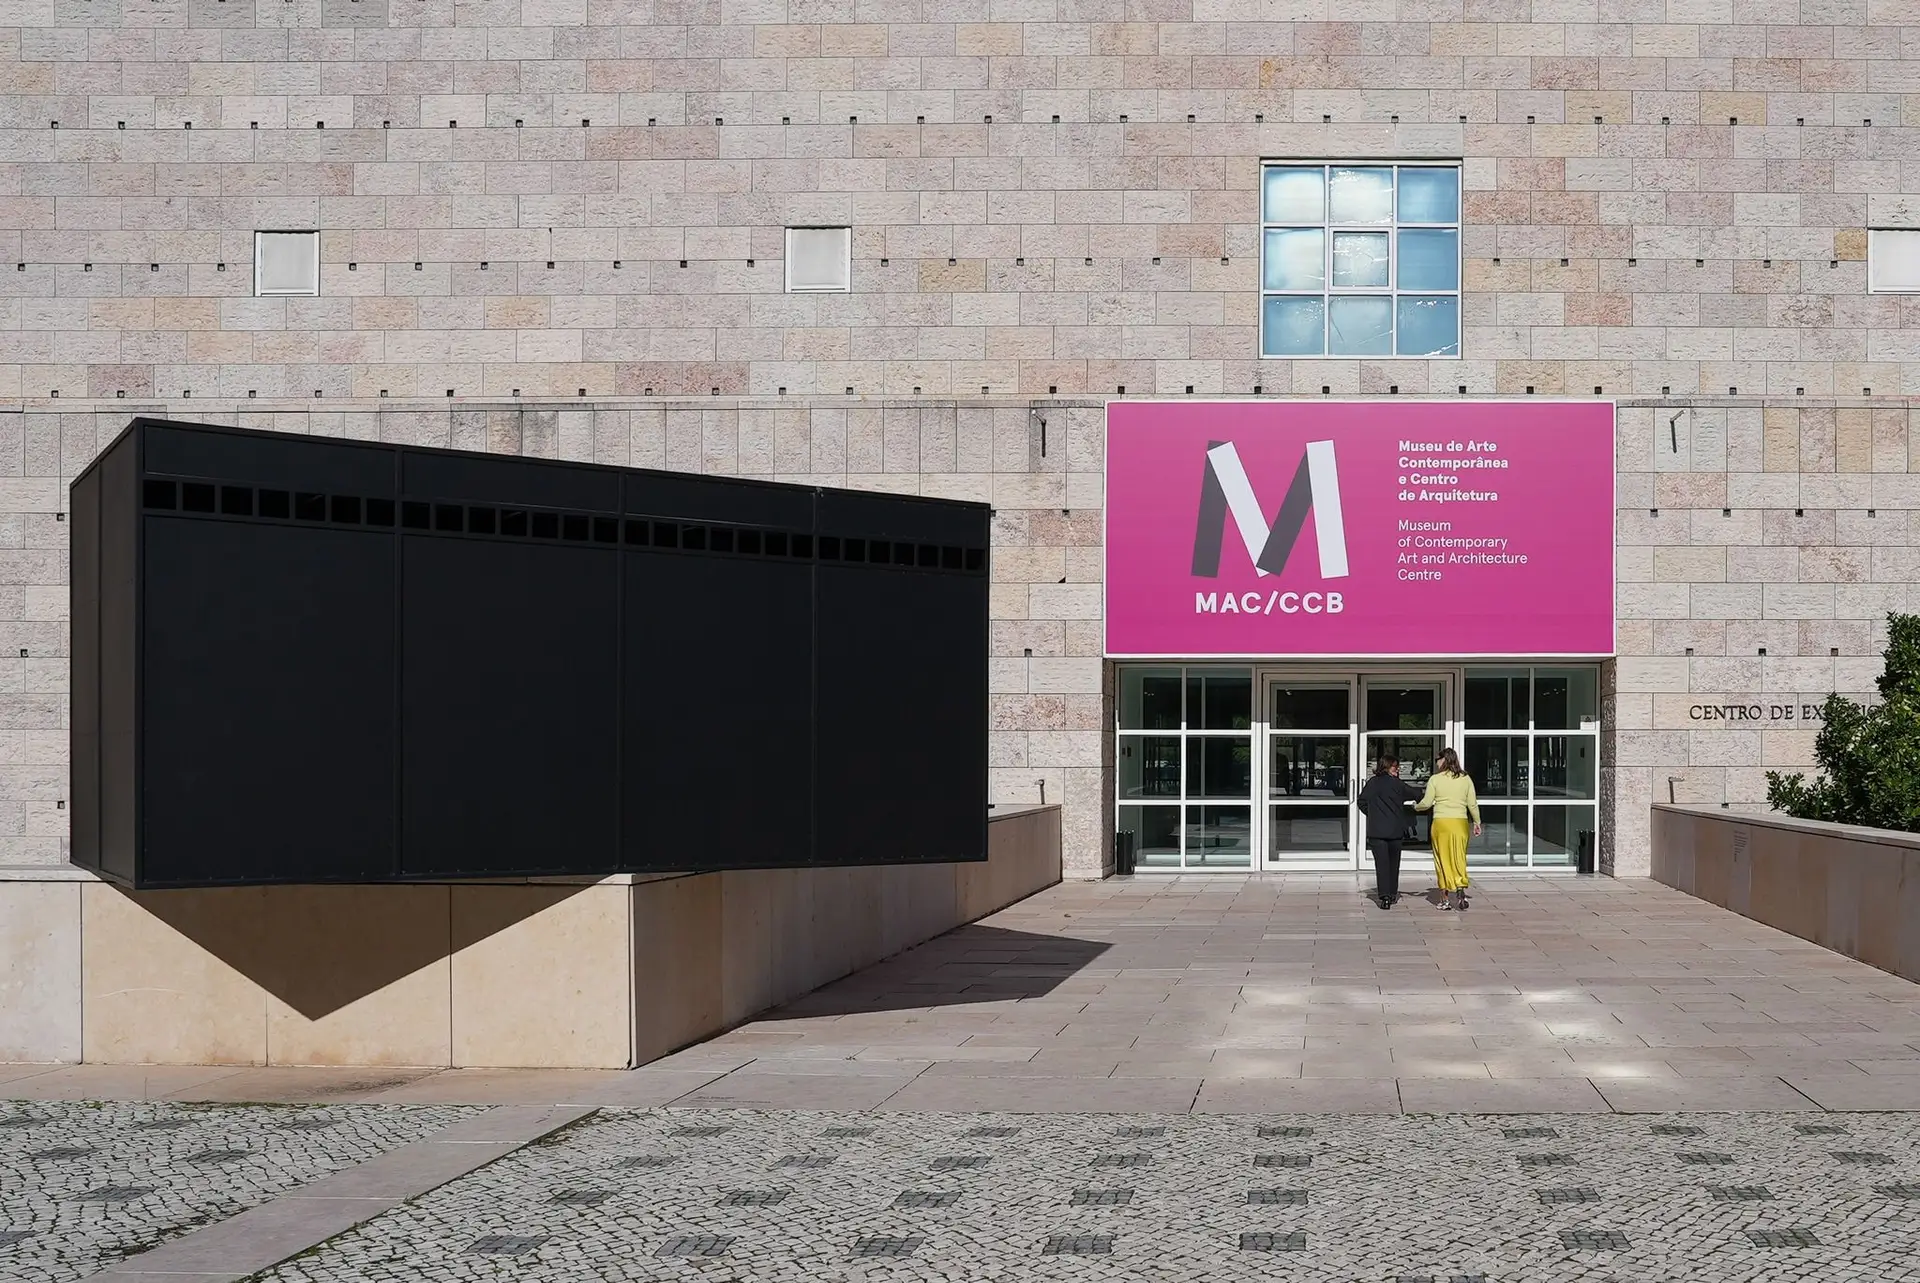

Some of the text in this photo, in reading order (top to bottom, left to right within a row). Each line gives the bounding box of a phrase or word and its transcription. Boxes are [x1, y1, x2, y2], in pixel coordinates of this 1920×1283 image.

[1398, 440, 1497, 452] Museu de Arte
[1398, 456, 1509, 471] Contemporânea
[1398, 473, 1459, 485] e Centro
[1398, 489, 1498, 504] de Arquitetura
[1398, 519, 1451, 531] Museum
[1397, 535, 1508, 550] of Contemporary
[1397, 552, 1528, 564] Art and Architecture
[1397, 568, 1442, 581] Centre
[1195, 590, 1345, 615] MAC/CCB
[1689, 704, 1763, 721] CENTRO
[1770, 704, 1795, 721] DE
